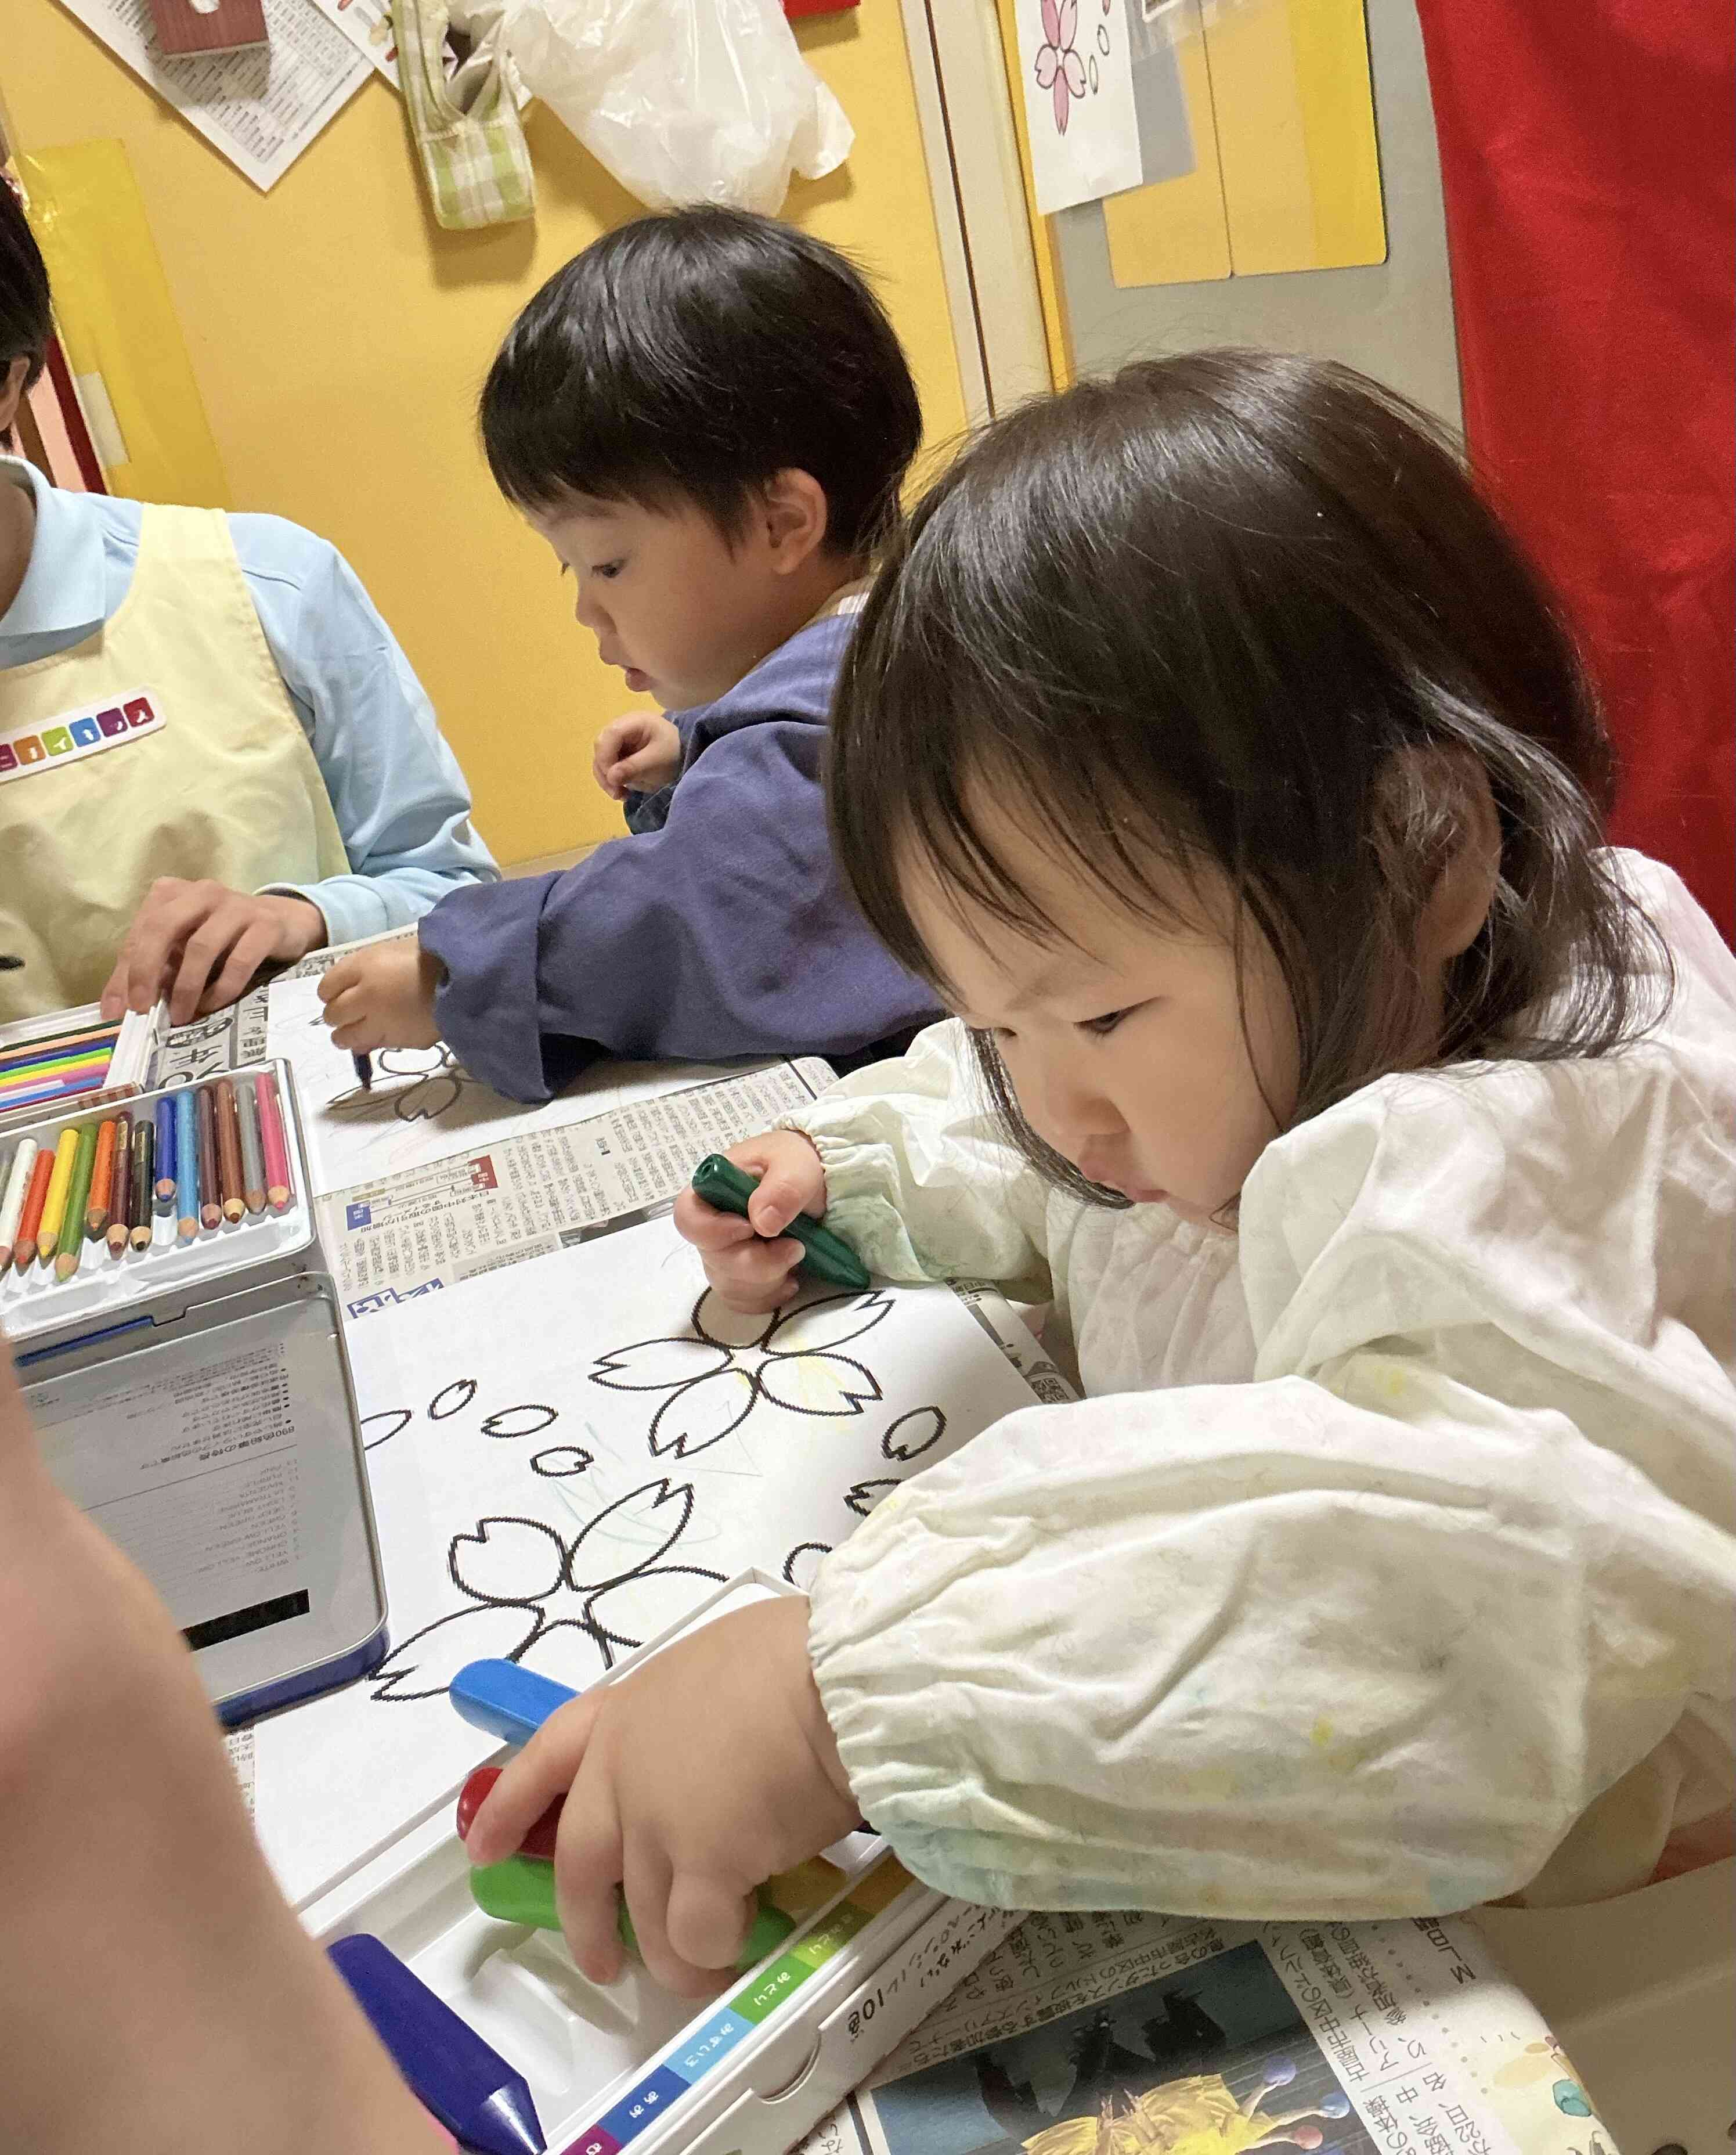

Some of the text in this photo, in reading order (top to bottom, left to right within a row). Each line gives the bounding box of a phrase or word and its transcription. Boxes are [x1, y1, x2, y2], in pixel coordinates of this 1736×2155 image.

[750, 1968, 794, 2009] みどり
[681, 2021, 736, 2072] みずいろ
[626, 2088, 661, 2121] あお
[1394, 2082, 1454, 2154] 協会、中
